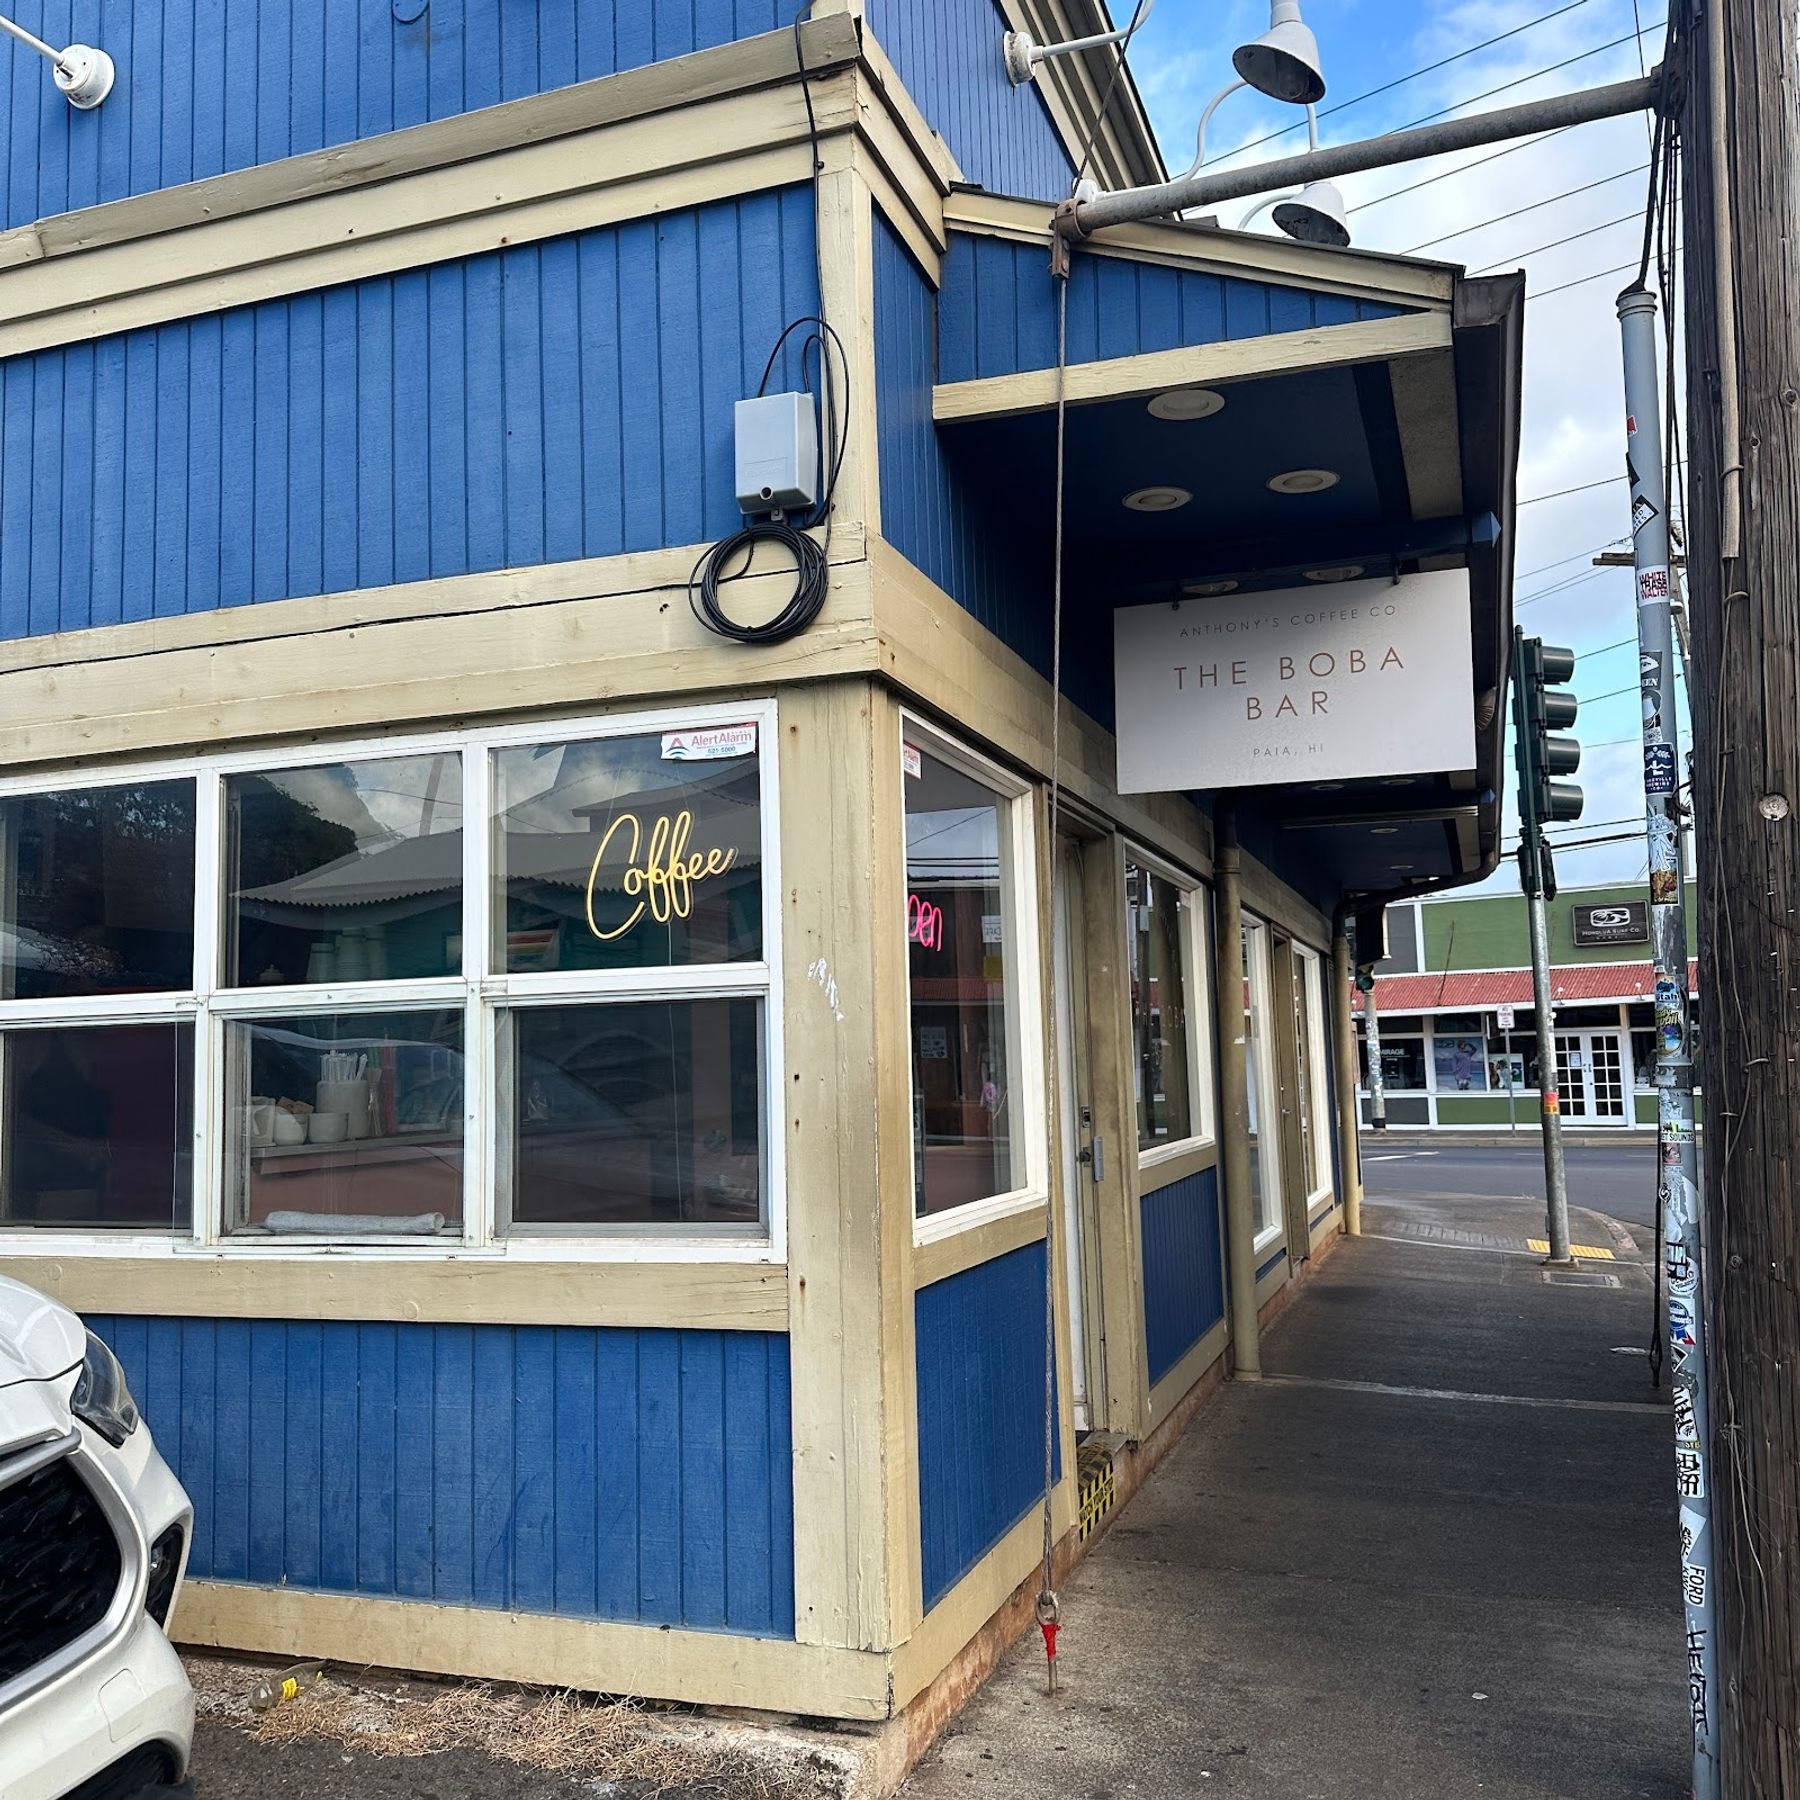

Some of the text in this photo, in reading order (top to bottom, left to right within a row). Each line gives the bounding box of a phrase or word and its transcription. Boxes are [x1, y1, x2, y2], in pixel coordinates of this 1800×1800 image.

[1639, 571, 1667, 581] WHITE
[1180, 604, 1396, 638] ANTHONY'S COFFEE CO
[1174, 646, 1404, 690] THE BOBA
[1247, 690, 1329, 720] BAR
[1308, 744, 1324, 754] HI
[587, 811, 735, 940] Coffee
[1689, 1565, 1705, 1606] FORD
